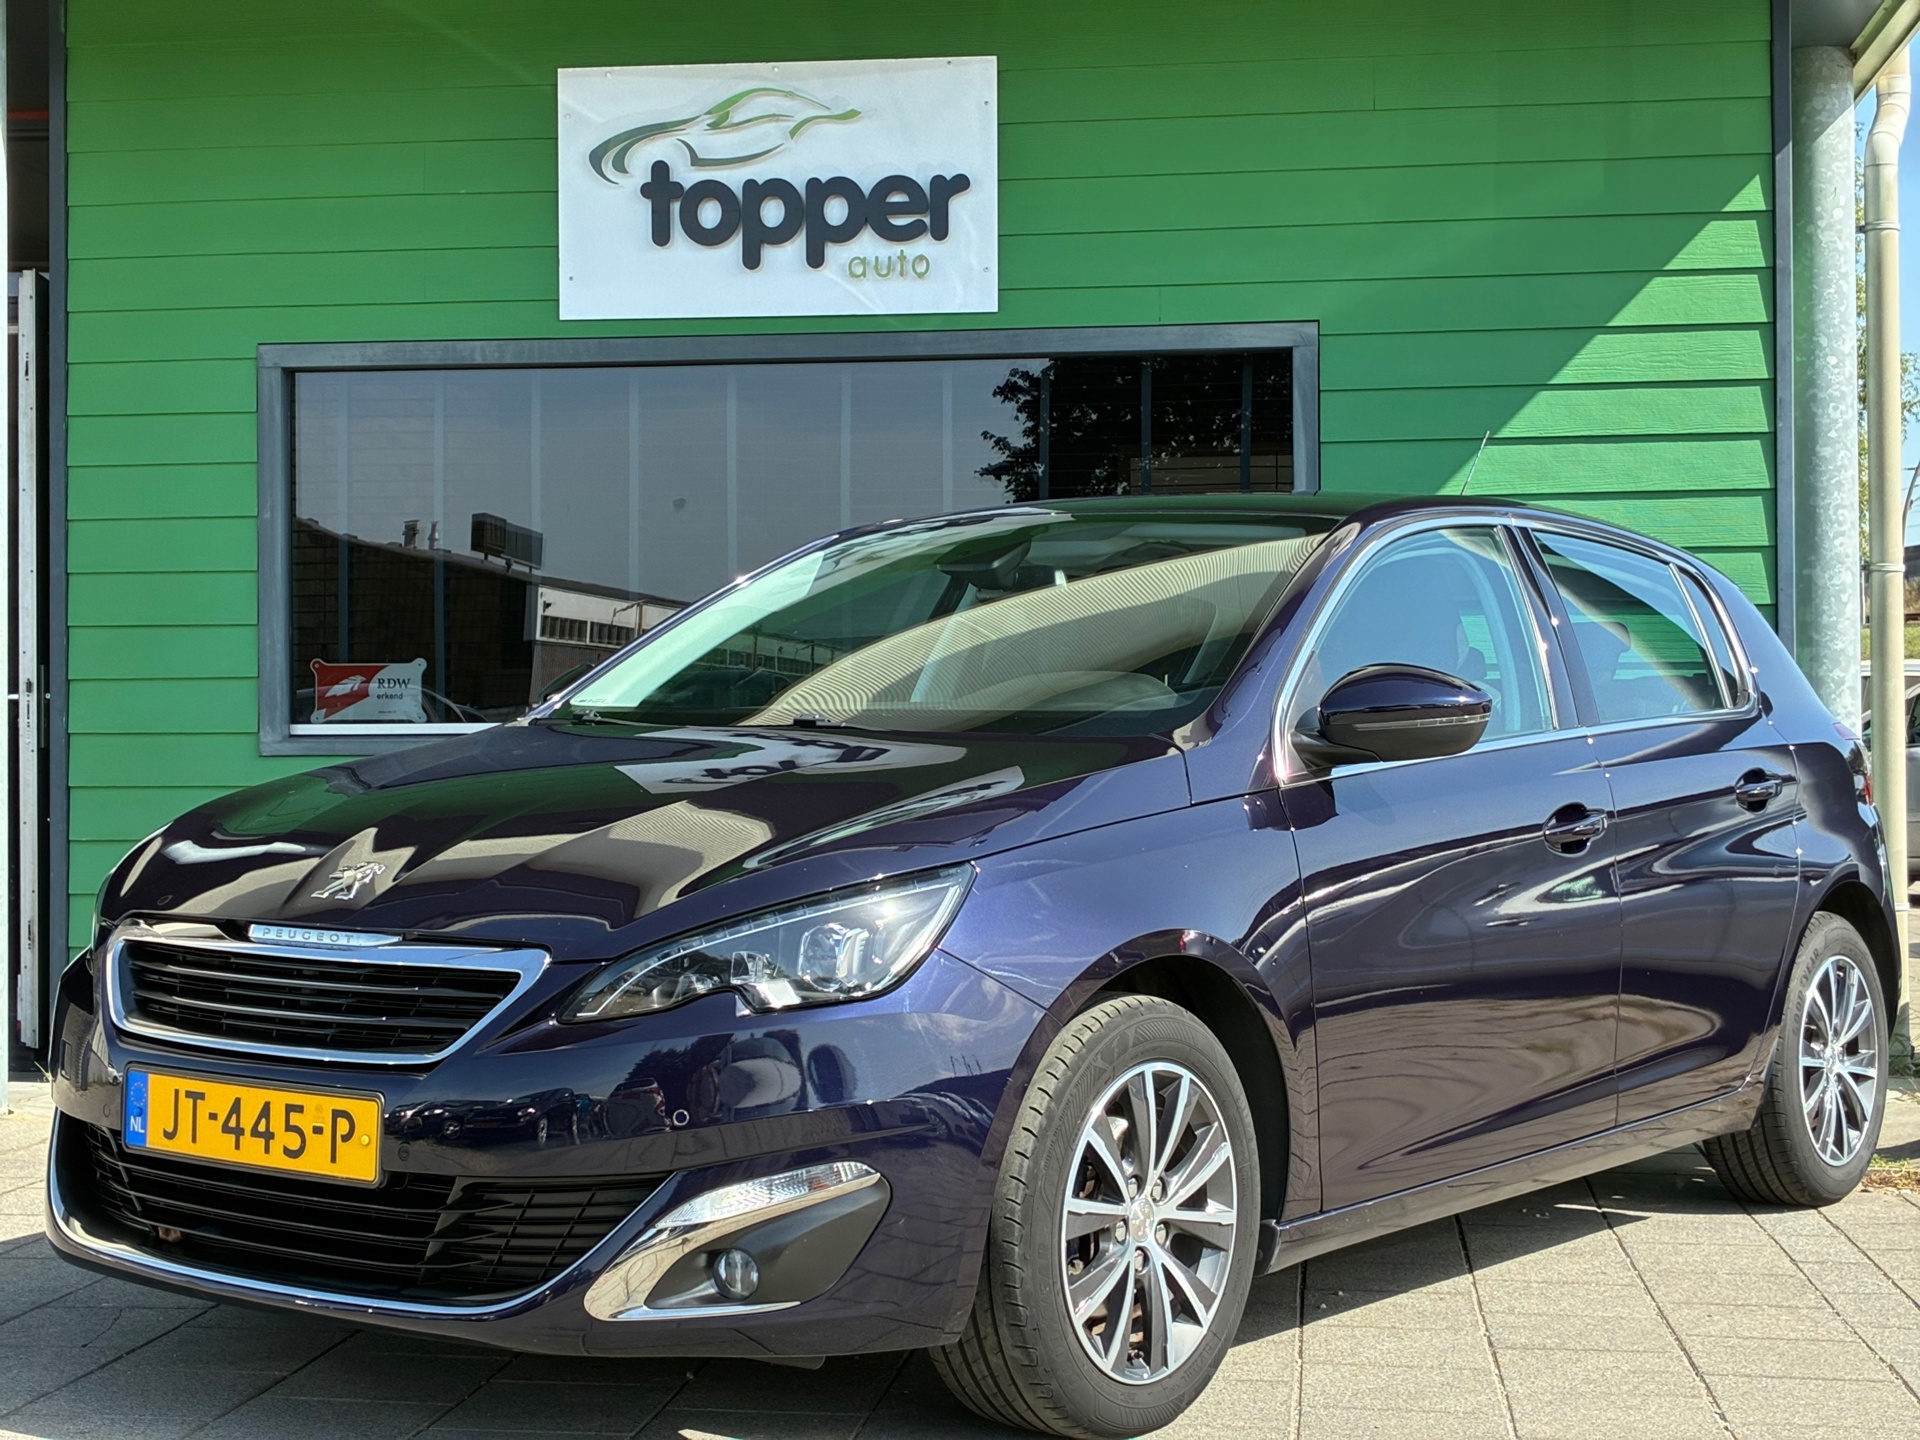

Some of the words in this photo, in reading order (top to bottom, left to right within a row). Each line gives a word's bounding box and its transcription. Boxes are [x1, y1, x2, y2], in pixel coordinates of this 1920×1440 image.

[639, 159, 971, 271] topper
[847, 249, 931, 279] auto
[377, 678, 411, 689] RDW
[376, 691, 404, 700] erkend
[262, 927, 354, 944] PEUGEOT
[130, 1115, 145, 1134] NL
[162, 1088, 356, 1164] JT-445-P
